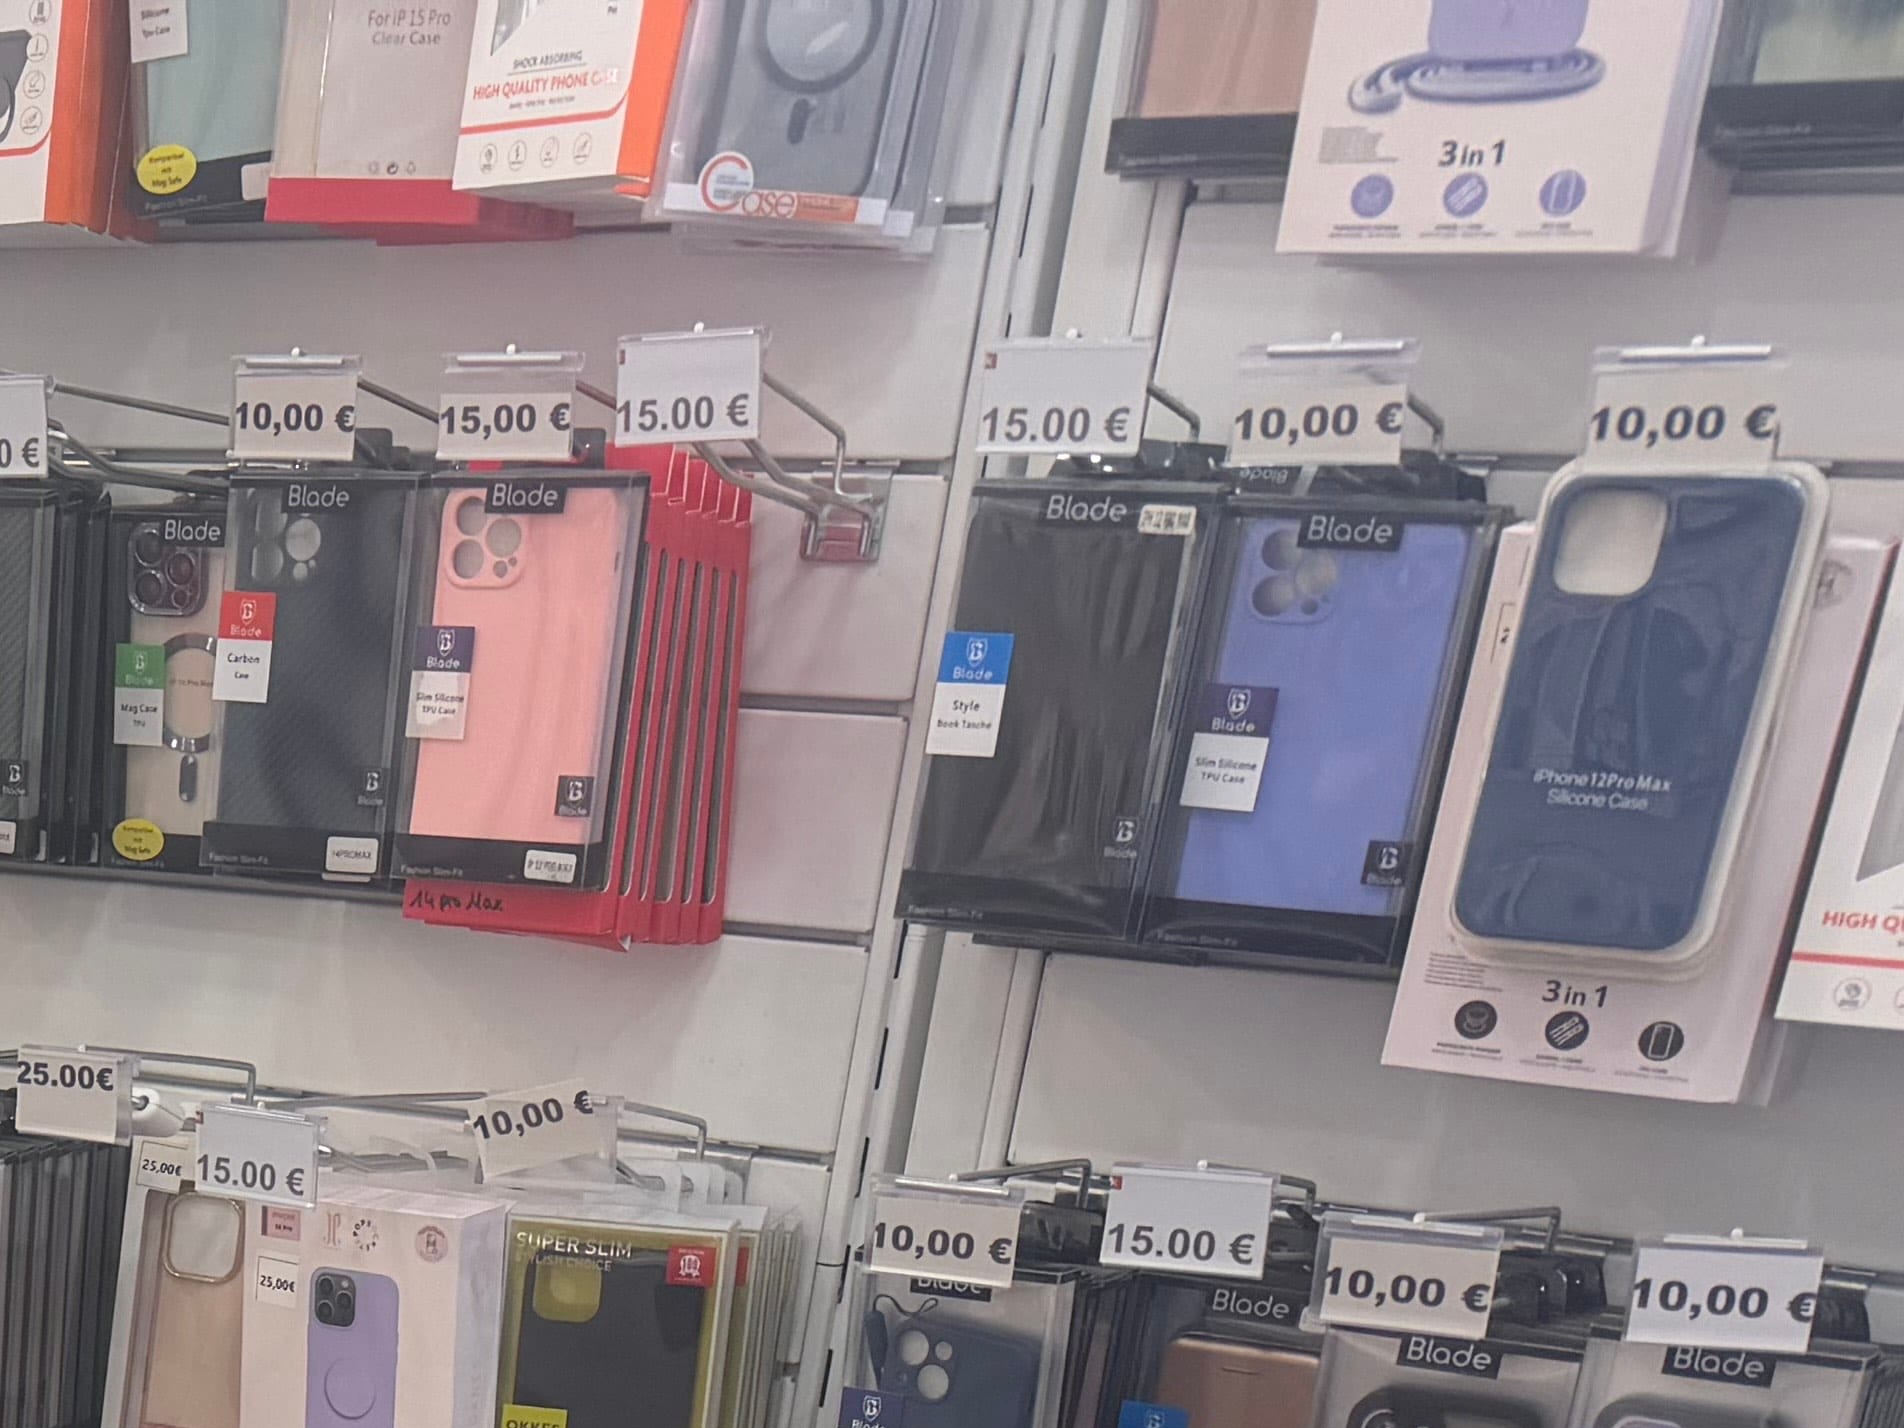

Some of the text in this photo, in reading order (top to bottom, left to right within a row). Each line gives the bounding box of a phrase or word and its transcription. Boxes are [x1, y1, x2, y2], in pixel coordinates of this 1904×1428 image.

[368, 10, 388, 27] For
[409, 11, 424, 26] 15
[427, 11, 450, 26] Pro
[409, 32, 440, 45] Case
[236, 403, 354, 436] 10,00 €
[441, 403, 570, 439] 15,00 €
[617, 393, 749, 432] 15.00 €
[982, 407, 1129, 444] 15.00 €
[1234, 402, 1402, 444] 10,00 €
[1592, 405, 1776, 451] 10,00 €
[22, 438, 39, 467] €
[288, 486, 349, 508] Blade
[493, 485, 558, 506] Blade
[1047, 497, 1126, 522] Blade
[1308, 517, 1392, 544] Blade
[953, 701, 980, 714] Style
[1547, 788, 1647, 809] Silicone Case
[473, 1090, 593, 1140] 10,00 €
[196, 1154, 304, 1196] 15.00 €
[517, 1233, 632, 1258] SUPER SLIM
[874, 1222, 1011, 1264] 10,00 €
[1108, 1223, 1255, 1264] 15.00 €
[1212, 1291, 1289, 1318] Blade
[1325, 1267, 1489, 1313] 10,00 €
[1407, 1338, 1491, 1371] Blade
